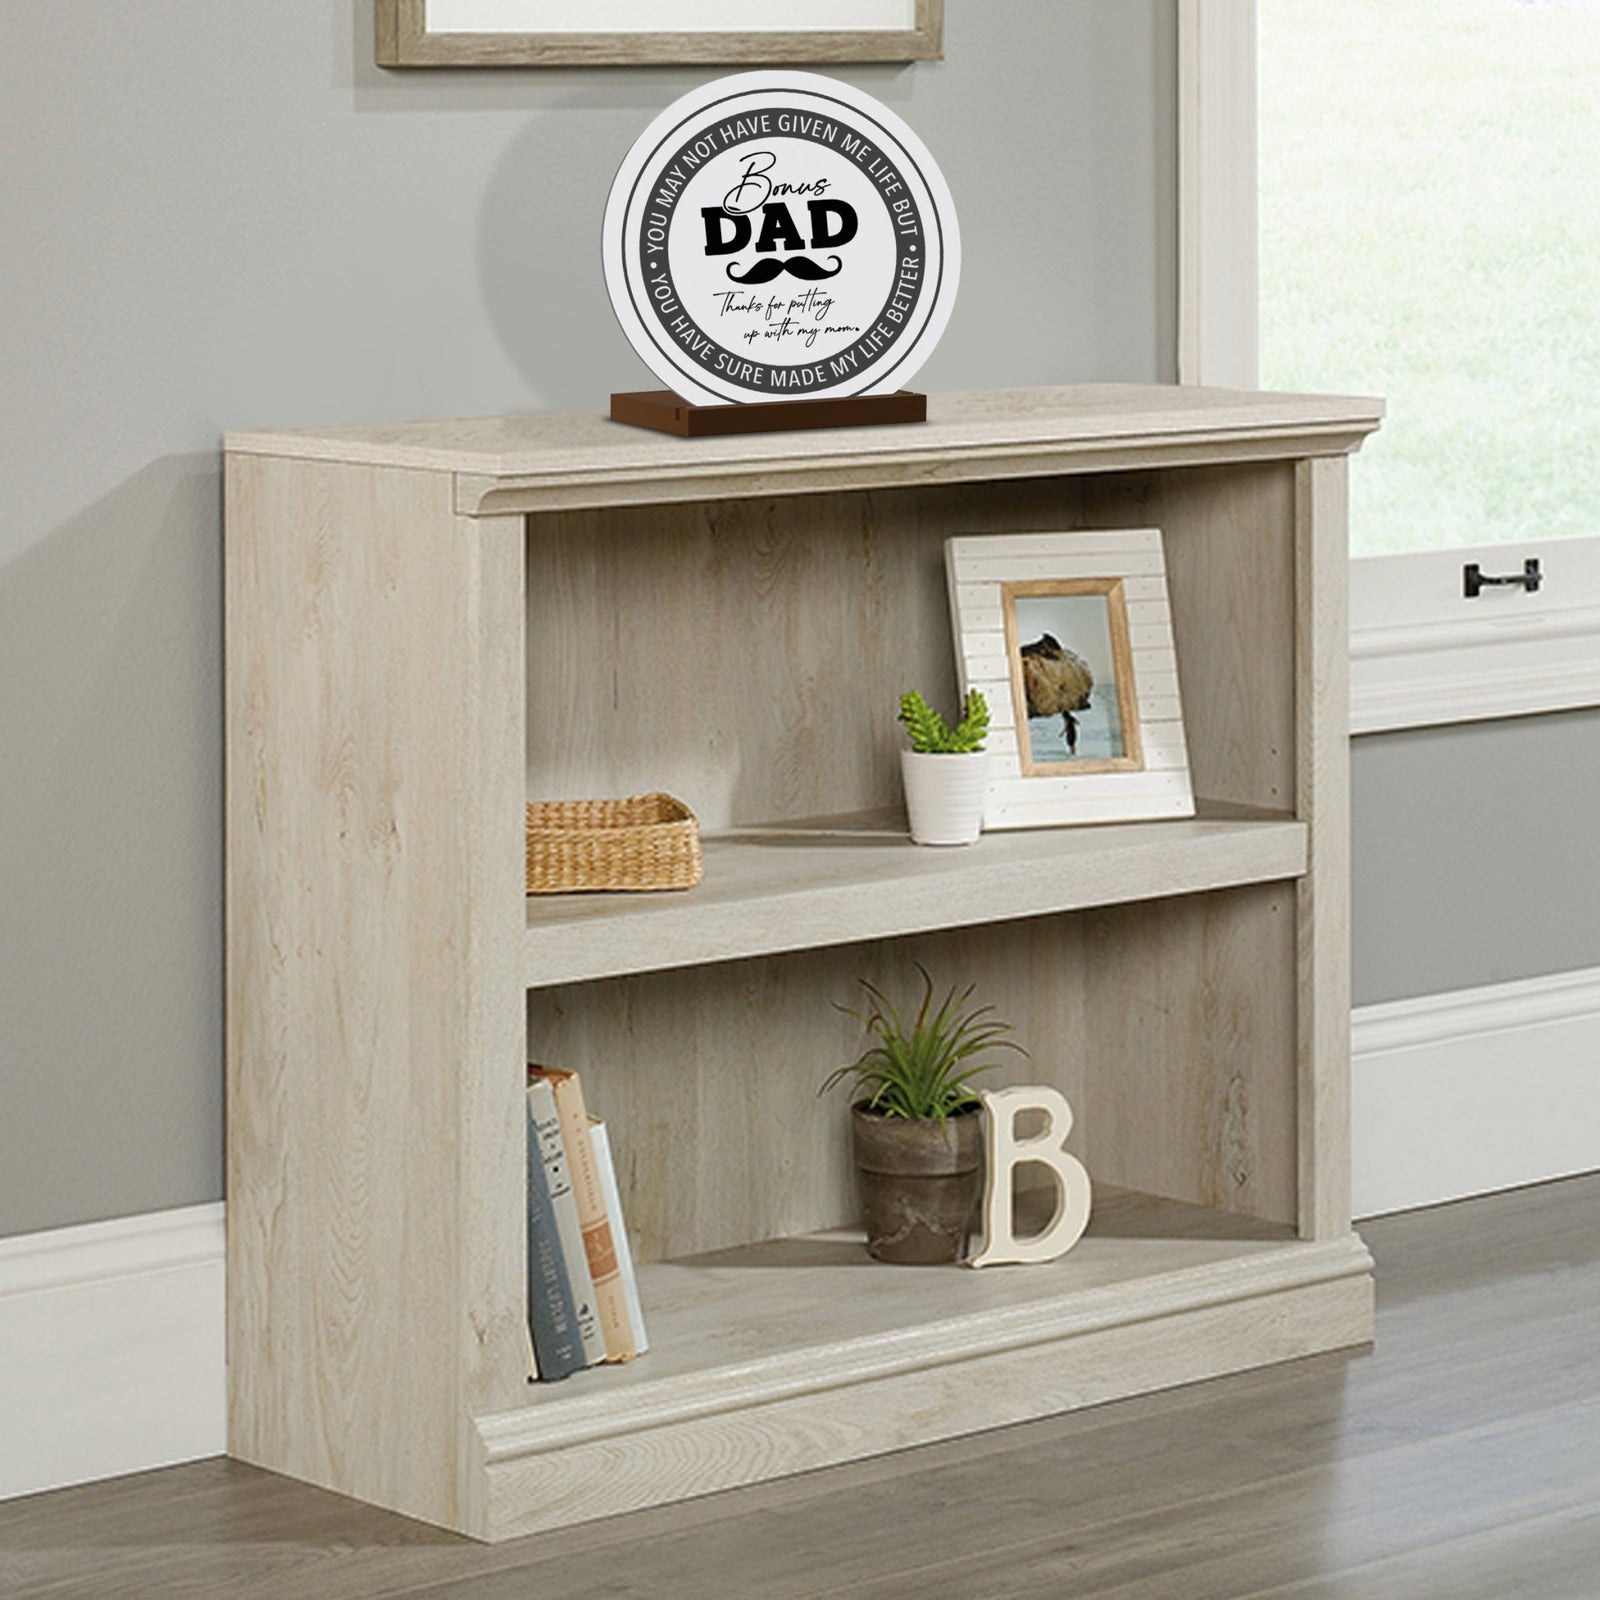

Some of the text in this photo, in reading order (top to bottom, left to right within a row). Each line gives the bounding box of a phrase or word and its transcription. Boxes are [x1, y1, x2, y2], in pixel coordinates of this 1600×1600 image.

[647, 114, 918, 253] YOU MAY NOT HAVE GIVEN ME LIFE BUT
[723, 151, 831, 215] Bonus
[701, 199, 858, 256] DAD
[651, 257, 919, 387] YOU HAVE SURE MADE MY LIFE BETTER
[713, 287, 835, 321] Thanks for putting
[743, 329, 760, 345] up
[764, 317, 799, 341] with
[797, 328, 818, 348] my
[964, 1085, 1092, 1268] B
